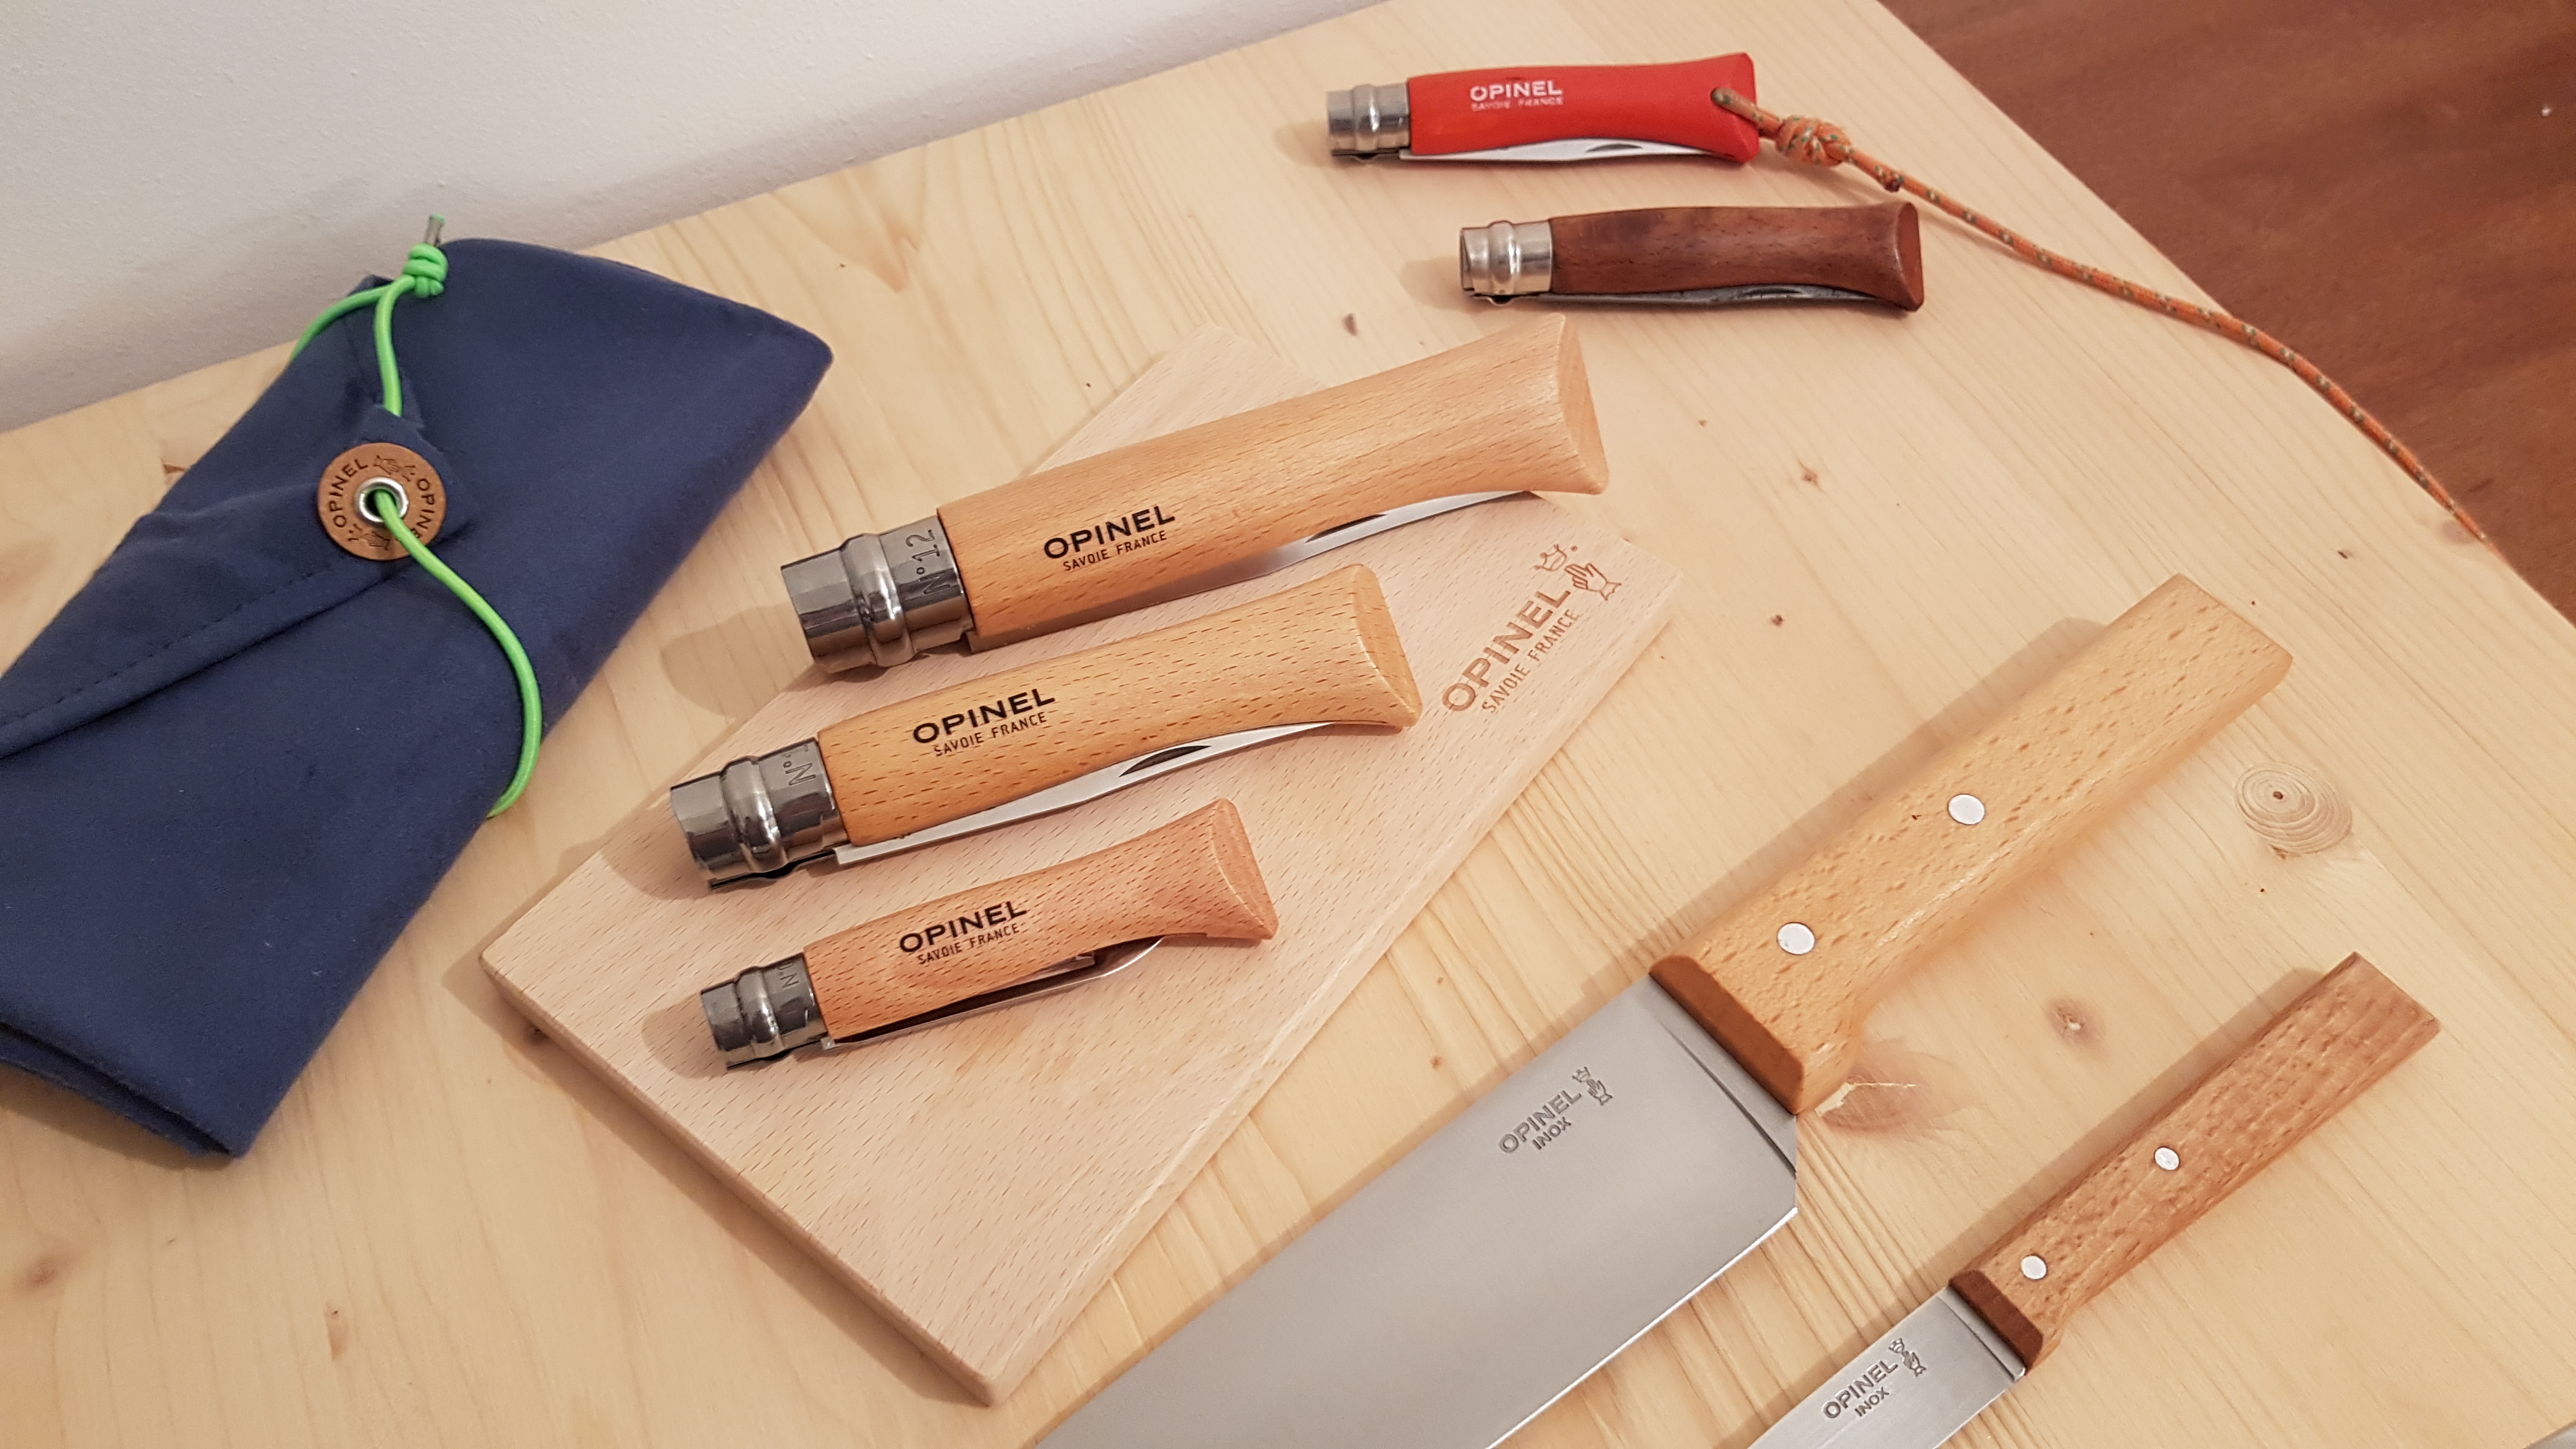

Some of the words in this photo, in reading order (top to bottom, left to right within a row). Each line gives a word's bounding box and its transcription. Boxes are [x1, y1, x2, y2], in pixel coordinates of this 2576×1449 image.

[1470, 80, 1563, 102] OPINEL
[328, 459, 369, 528] OPINEL
[1044, 506, 1176, 559] OPINEL
[1063, 549, 1110, 572] SAVOIE
[1116, 530, 1168, 555] FRANCE
[1442, 590, 1571, 712] OPINEL
[1482, 663, 1530, 713] SAVOIE
[1527, 609, 1581, 662] FRANCE
[913, 689, 1055, 744] OPINEL
[933, 732, 985, 757] SAVOIE
[992, 711, 1047, 739] FRANCE
[900, 901, 1027, 953] OPINEL
[917, 942, 963, 965] SAVOIE
[969, 923, 1020, 949] FRANCE
[1499, 1090, 1583, 1153] OPINEL
[1532, 1117, 1572, 1151] INOX
[1822, 1360, 1899, 1419] OPINEL
[1854, 1386, 1890, 1418] INOX
